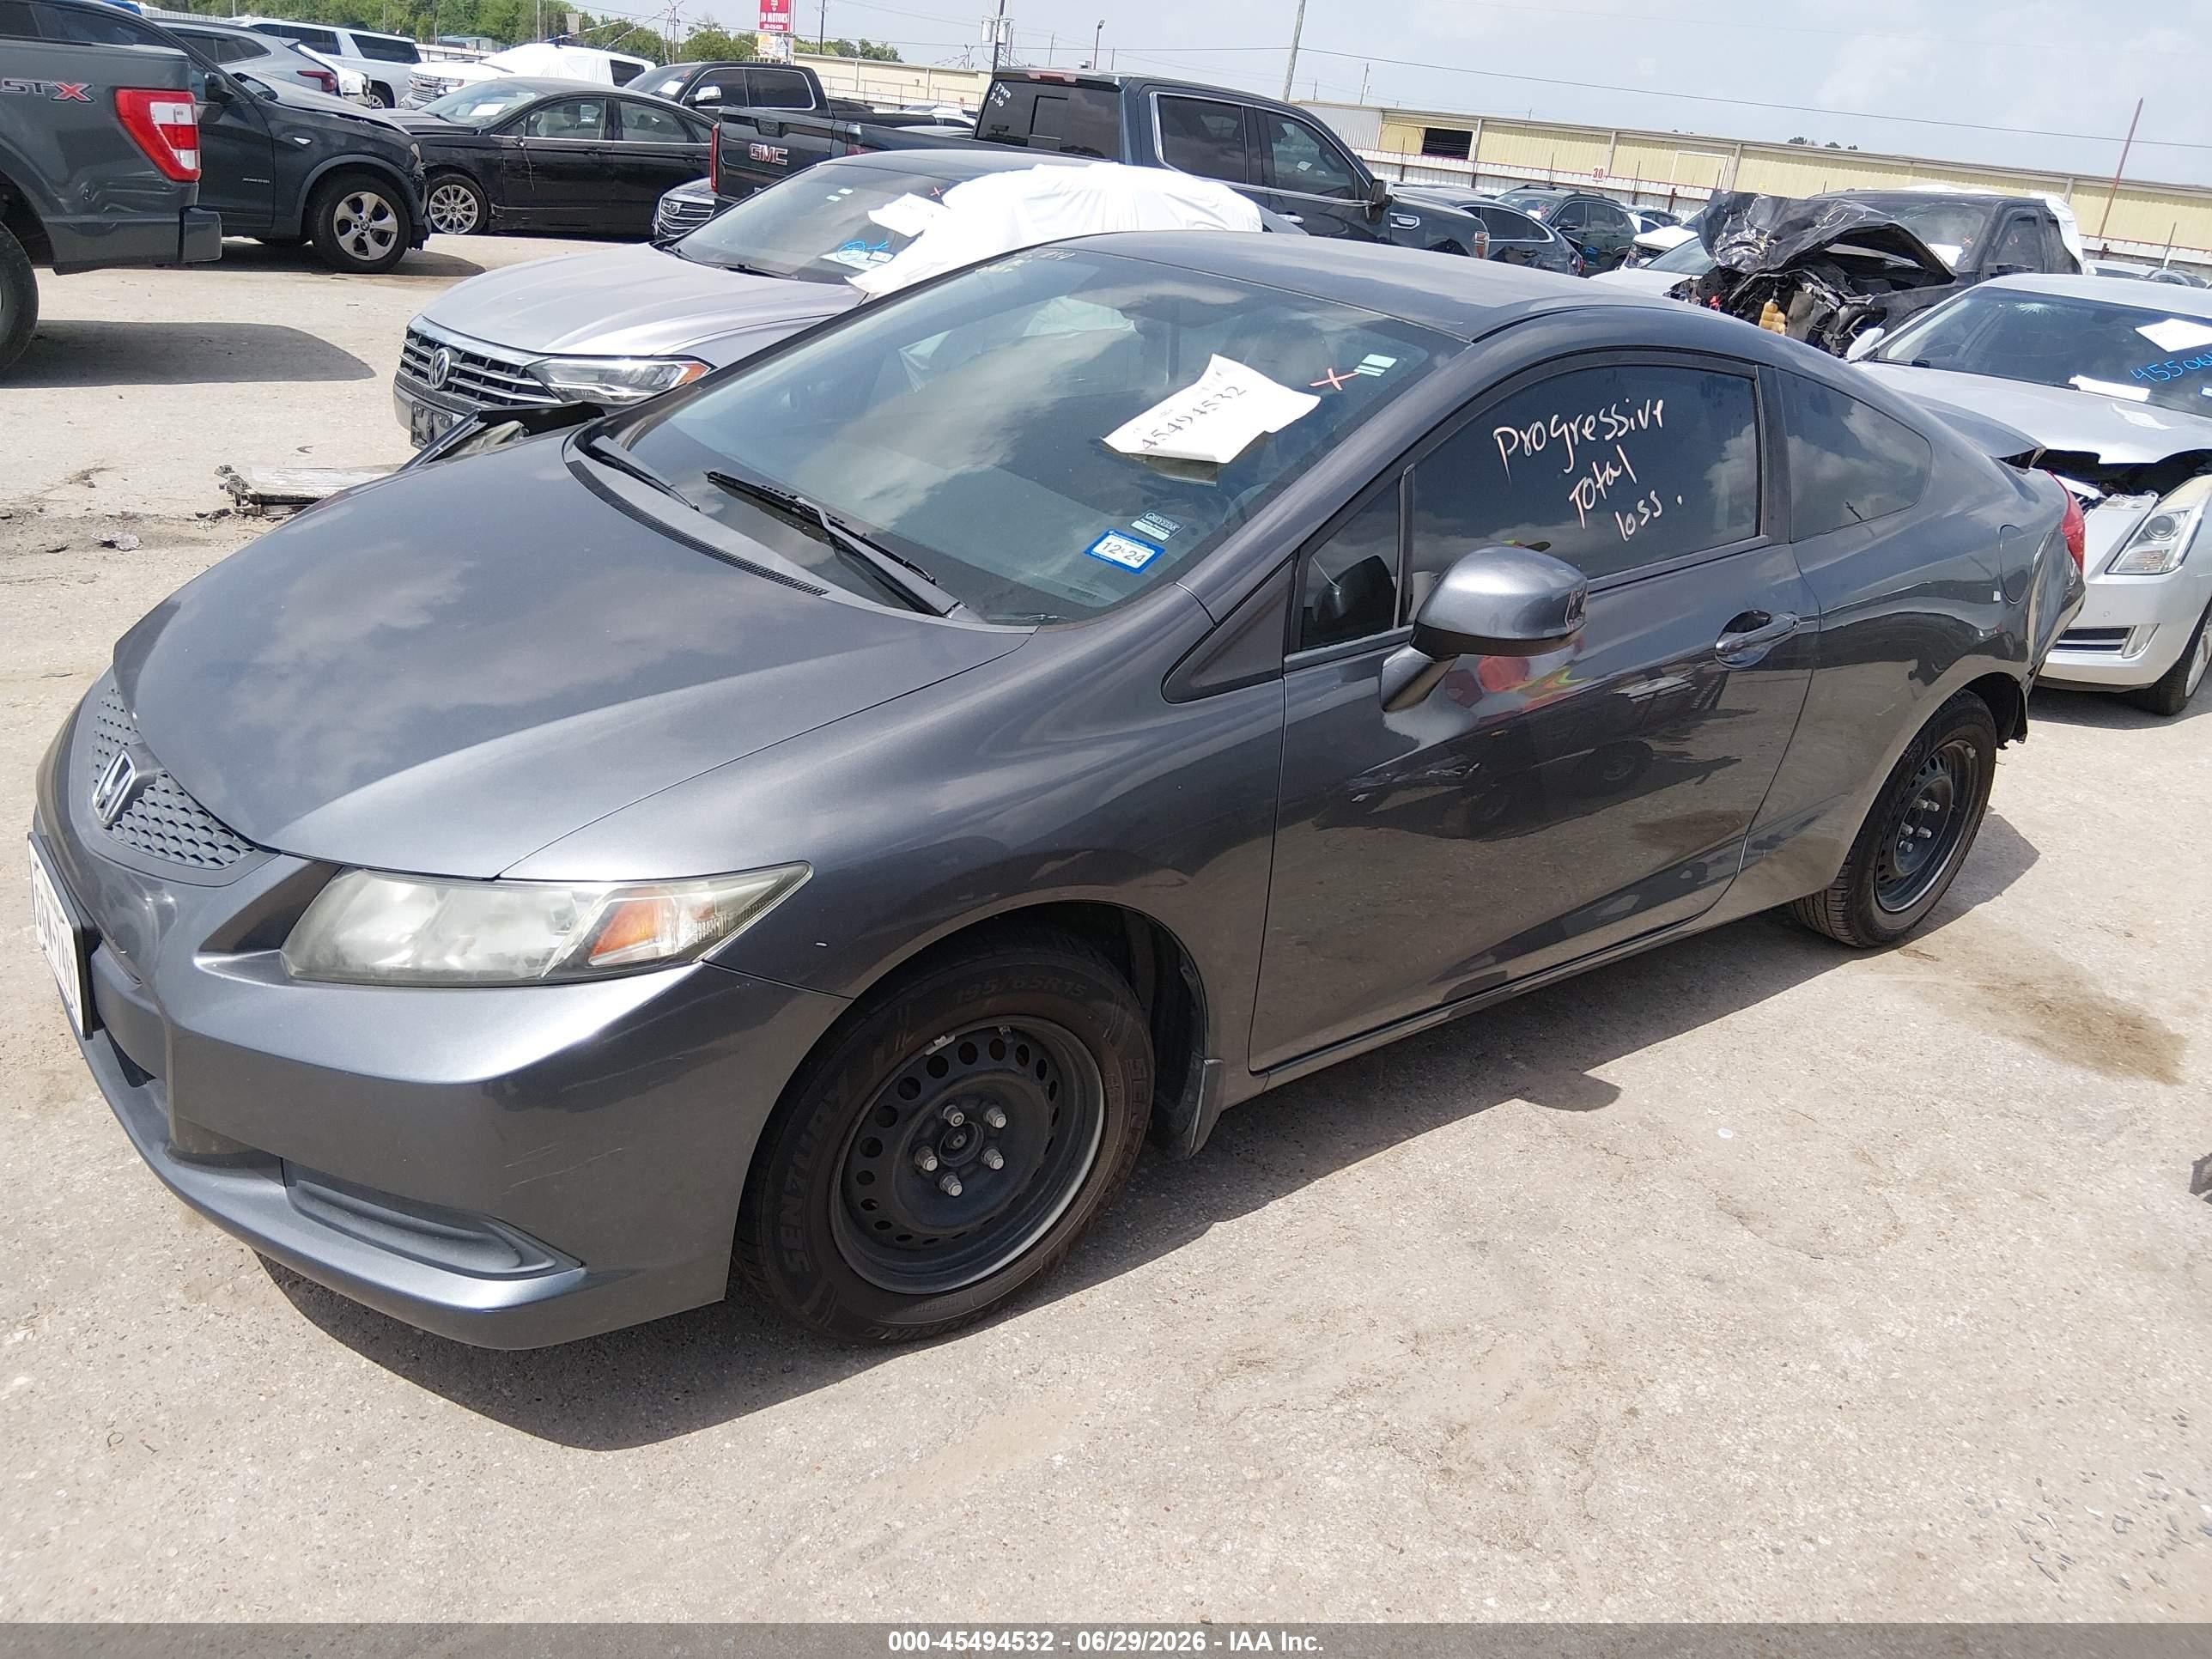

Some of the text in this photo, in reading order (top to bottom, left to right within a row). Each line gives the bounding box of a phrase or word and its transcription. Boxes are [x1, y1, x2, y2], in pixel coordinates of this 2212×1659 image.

[0, 78, 95, 103] STX
[750, 143, 788, 165] GMC
[1593, 167, 1604, 179] 30
